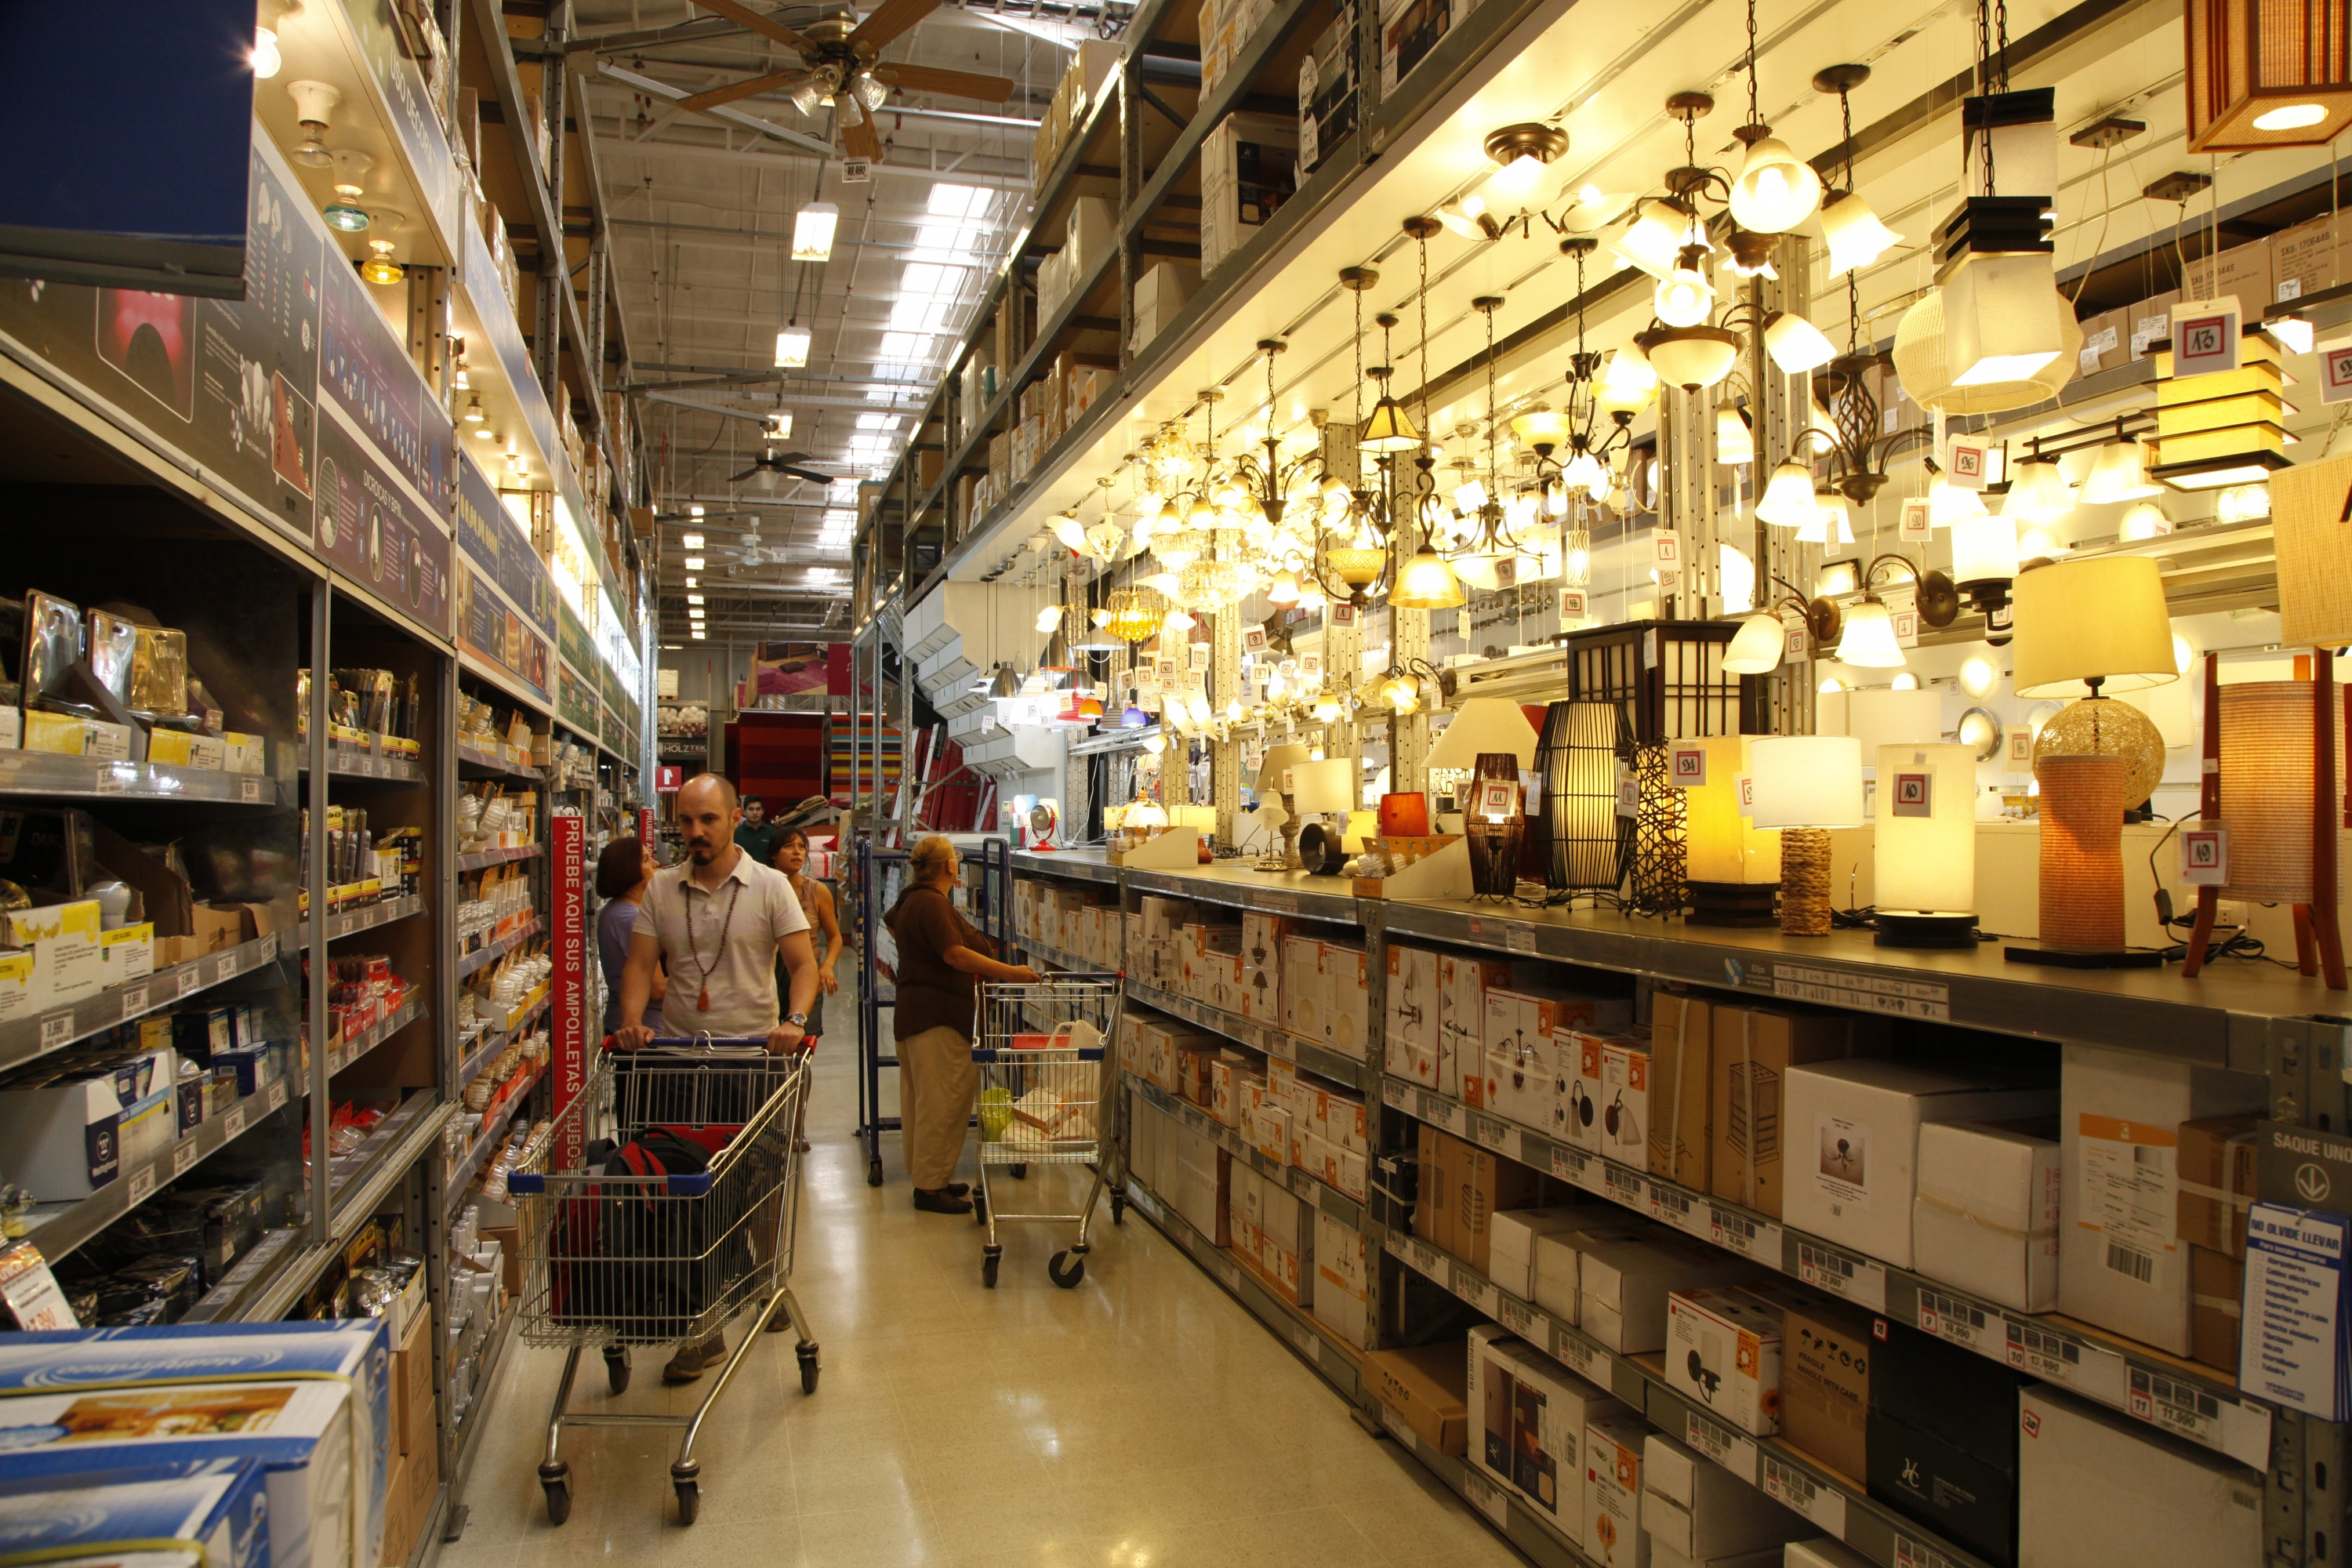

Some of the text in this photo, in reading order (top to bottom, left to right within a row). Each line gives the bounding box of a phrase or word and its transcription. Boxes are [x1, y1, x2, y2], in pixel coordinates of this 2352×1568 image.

[2299, 231, 2330, 249] 1706446
[2206, 263, 2235, 280] 176446
[2191, 328, 2215, 351] 13
[565, 820, 580, 888] PRUEBE
[564, 892, 583, 934] AQUÍ
[565, 938, 580, 972] SUS
[1751, 964, 1765, 975] Elija
[565, 980, 581, 1093] AMPOLLETAS
[2274, 1131, 2352, 1164] SAQUE UNO
[2251, 1218, 2340, 1250] NO OLVIDE LLEVAR
[1806, 1268, 1812, 1278] 8
[1820, 1272, 1842, 1288] 29.990
[1926, 1316, 1933, 1327] 9
[1798, 1352, 1825, 1373] FRAGILE
[2011, 1349, 2023, 1364] 10
[1796, 1363, 1859, 1403] HANDLE WITH CARE
[2134, 1398, 2147, 1413] 11
[2161, 1405, 2196, 1429] 11.990
